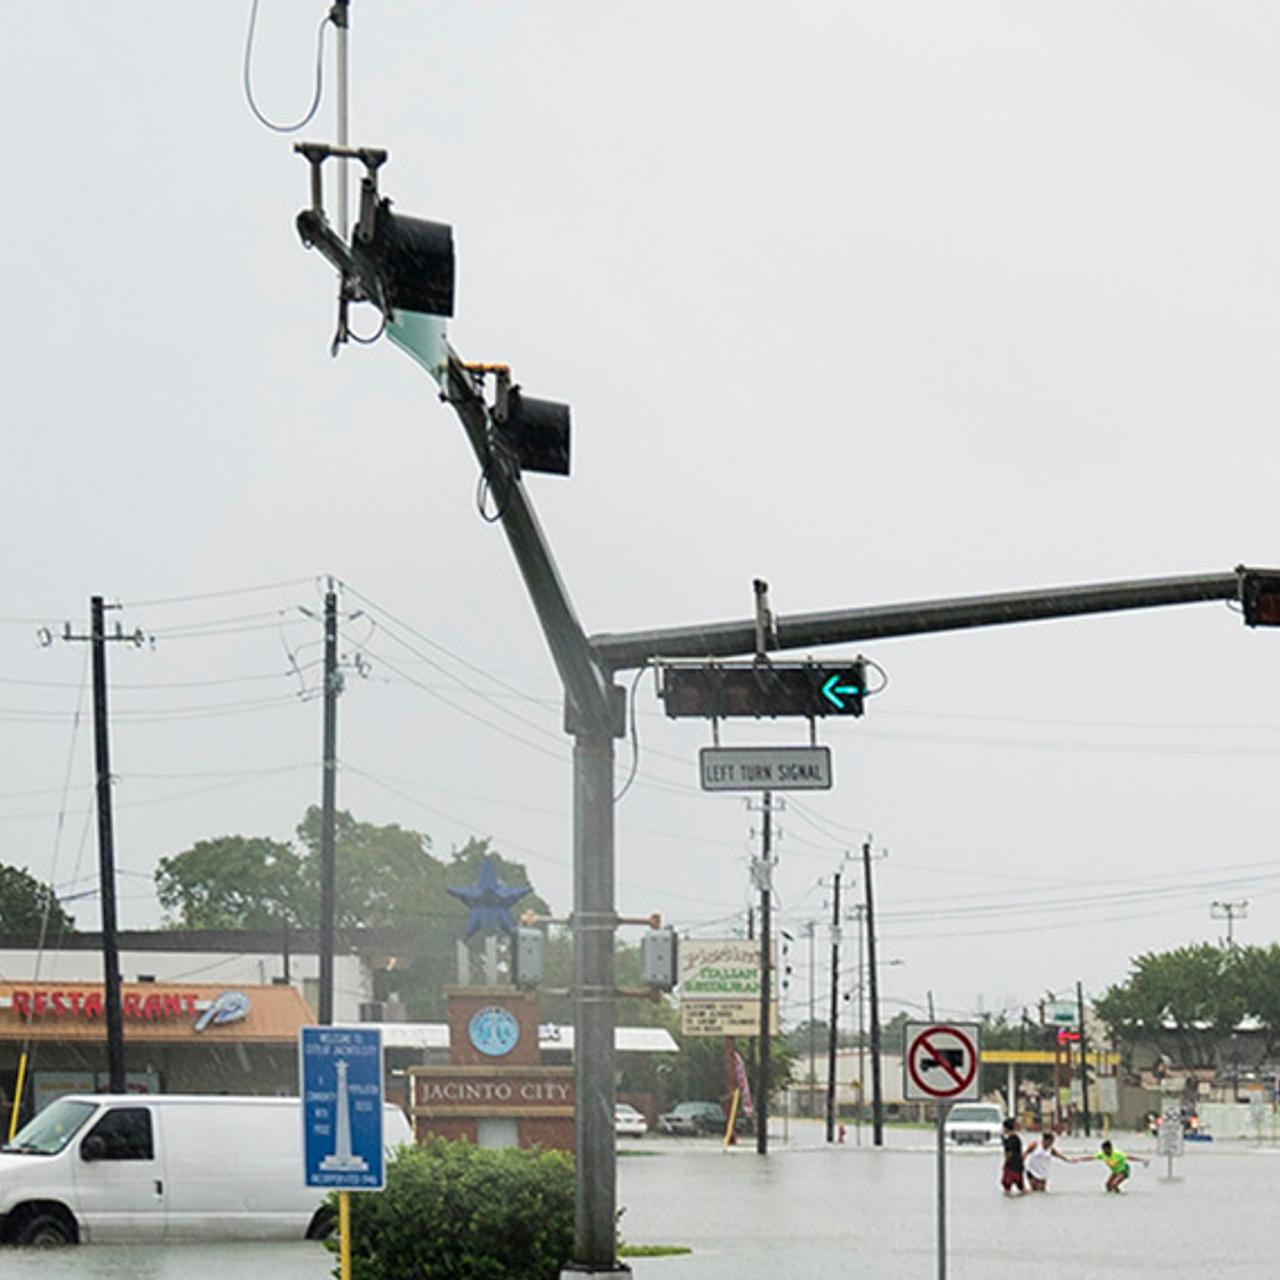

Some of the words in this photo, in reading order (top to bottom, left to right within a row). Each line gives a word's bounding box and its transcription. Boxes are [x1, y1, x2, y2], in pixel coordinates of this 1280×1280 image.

[706, 764, 735, 782] LEFT
[740, 764, 773, 781] TURN
[778, 764, 822, 781] SIGNAL
[12, 990, 199, 1021] RESTARANT
[422, 1083, 512, 1103] JACINTO
[520, 1083, 570, 1101] CITY
